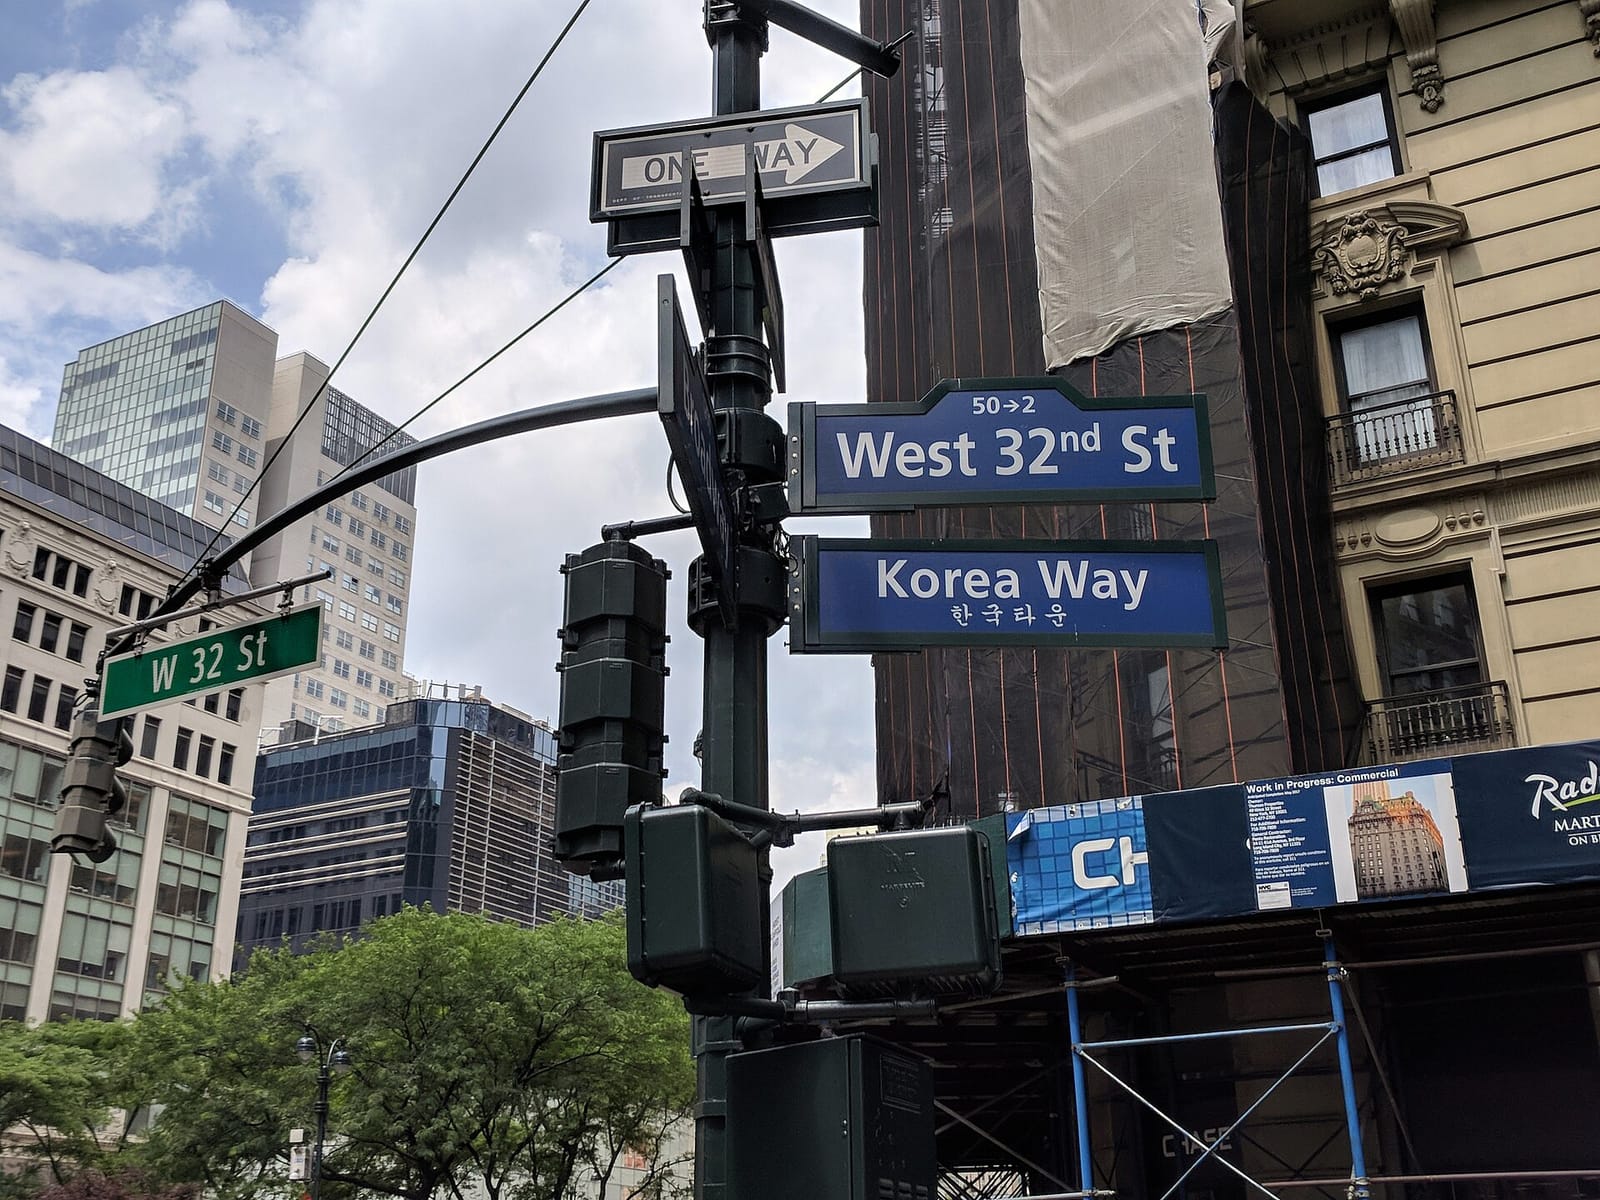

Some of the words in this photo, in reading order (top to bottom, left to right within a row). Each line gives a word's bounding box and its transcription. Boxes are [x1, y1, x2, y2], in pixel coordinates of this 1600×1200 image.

[645, 151, 709, 182] ONE
[836, 431, 977, 479] West
[994, 422, 1102, 477] 32nd
[1121, 425, 1179, 474] St
[877, 559, 1021, 600] Korea
[1037, 559, 1149, 611] Way
[950, 602, 1068, 629] 한국타운
[152, 654, 179, 694] W
[189, 642, 225, 684] 32
[236, 630, 268, 672] St
[1246, 783, 1273, 794] Work
[1274, 781, 1284, 791] in
[1286, 777, 1335, 790] Progress:
[1337, 767, 1399, 783] Commercial
[1524, 760, 1600, 820] Rad
[1568, 835, 1588, 846] ON
